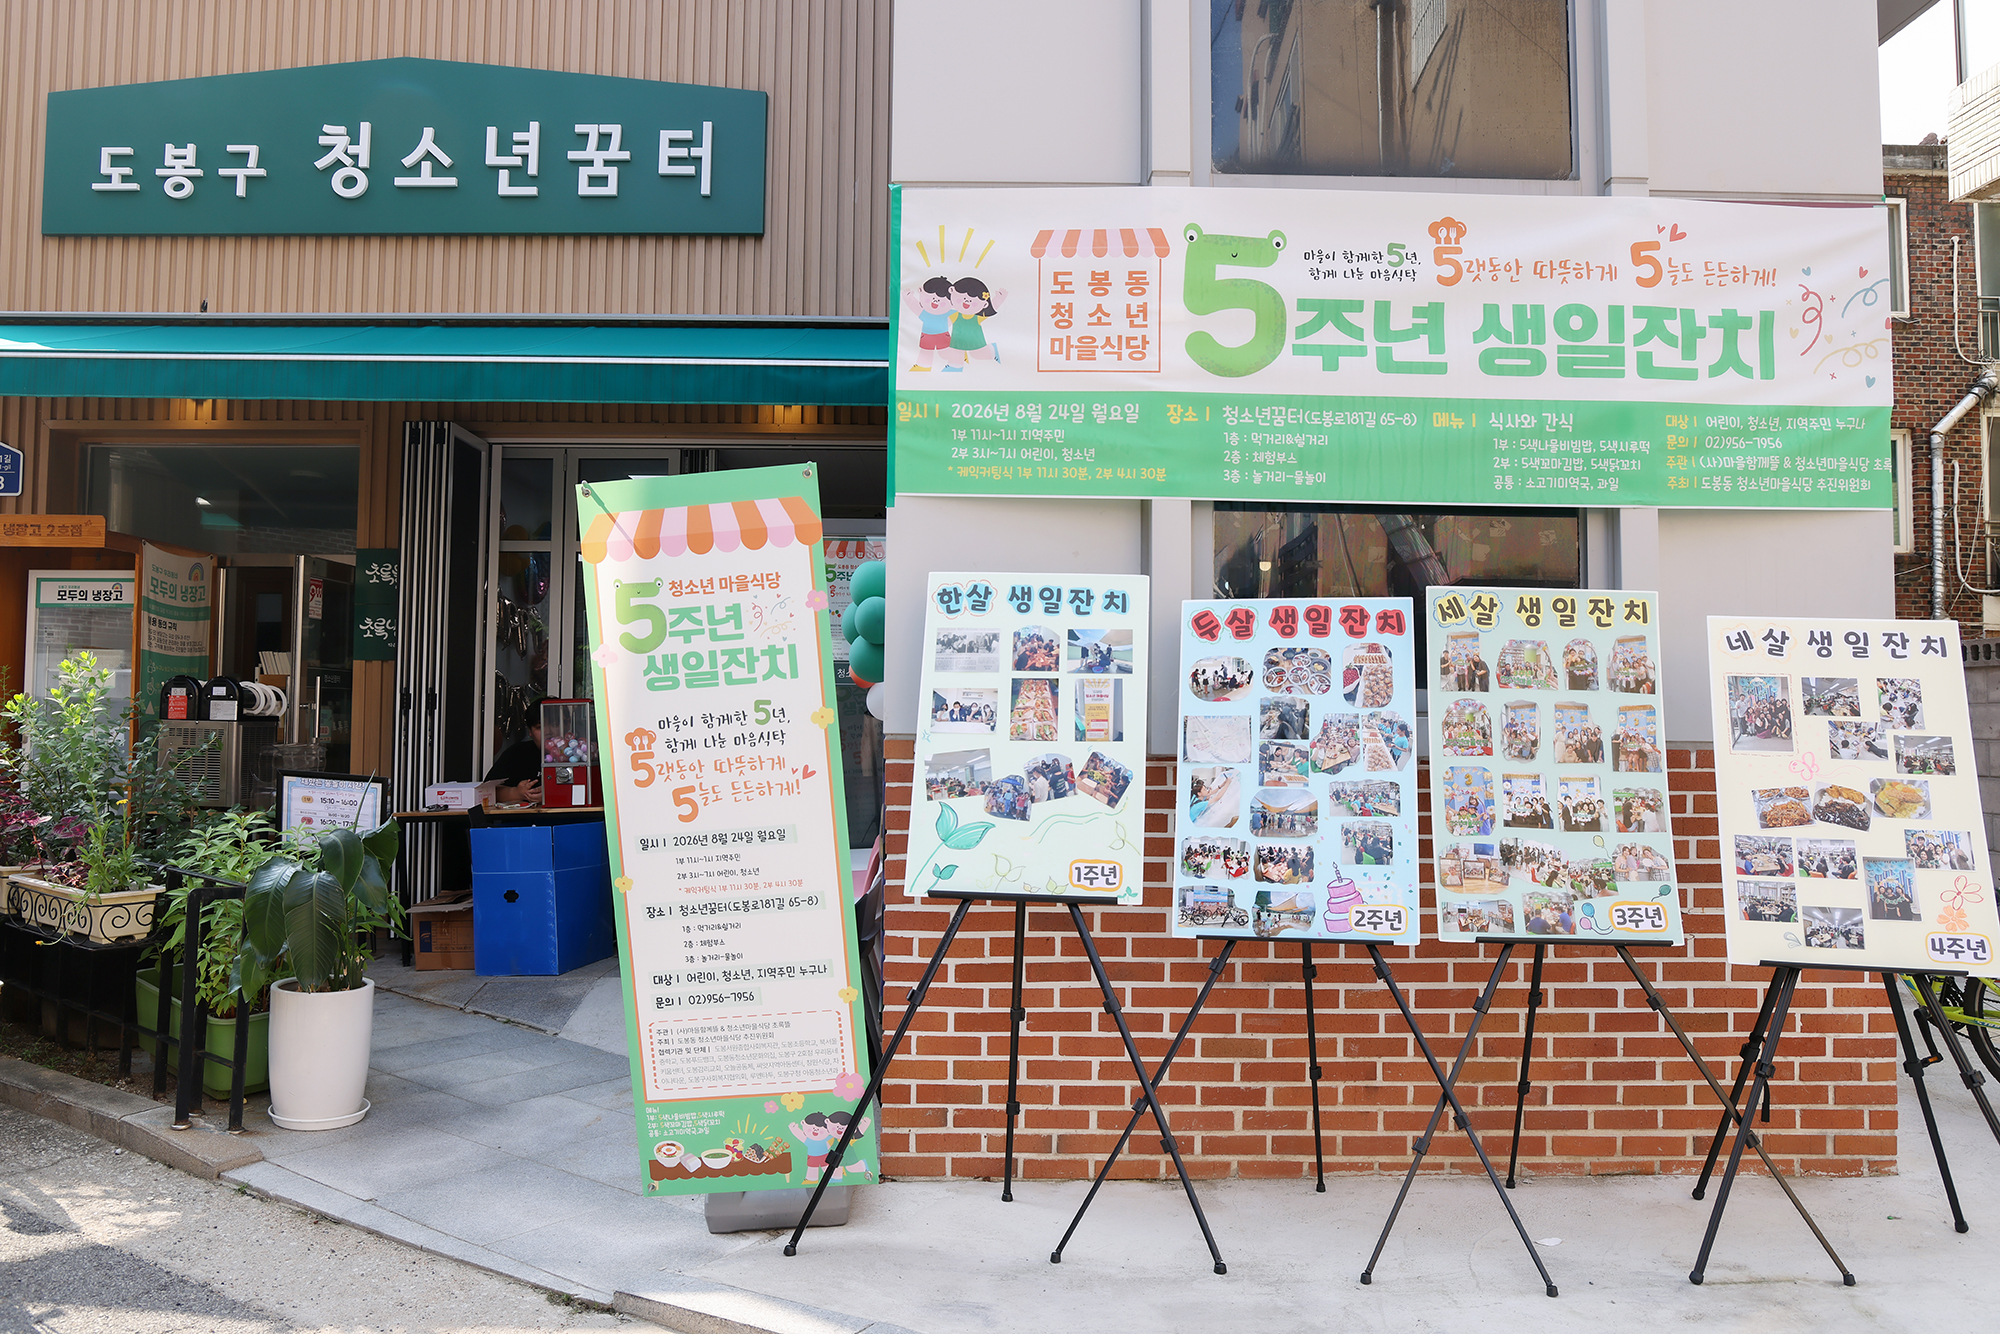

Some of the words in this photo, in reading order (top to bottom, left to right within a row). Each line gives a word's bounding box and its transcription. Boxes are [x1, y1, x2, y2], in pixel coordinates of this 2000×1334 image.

[91, 142, 268, 200] 도봉구
[313, 120, 716, 200] 청소년꿈터
[1304, 248, 1336, 264] 마을이
[1342, 250, 1384, 265] 함께한
[1387, 243, 1421, 268] 5년,
[1433, 246, 1523, 287] 5랫동안
[1533, 258, 1618, 285] 따뜻하게
[1630, 240, 1694, 288] 5늘도
[1703, 260, 1777, 287] 든든하게!
[1050, 270, 1150, 298] 도봉동
[1308, 267, 1337, 281] 함께
[1370, 268, 1417, 282] 마음식탁
[1183, 223, 1448, 379] 5주년
[1472, 303, 1776, 381] 생일잔치
[1050, 302, 1149, 330] 청소년
[1050, 334, 1150, 362] 마을식당
[897, 402, 928, 422] 일시
[951, 403, 1009, 422] 2026년
[1015, 403, 1042, 423] 8월
[1048, 404, 1085, 423] 24일
[1092, 404, 1140, 424] 월요일
[1167, 404, 1199, 424] 장소
[1222, 405, 1377, 428] 청소년꿈터(도봉로181길
[1380, 411, 1418, 427] 65-8)
[1432, 412, 1465, 429] 메뉴
[1489, 412, 1537, 431] 식사와
[1542, 412, 1574, 432] 간식
[1665, 414, 1689, 429] 대상
[1705, 415, 1743, 430] 어린이,
[1747, 416, 1782, 432] 청소년,
[1786, 417, 1832, 432] 지역주민
[1835, 417, 1866, 431] 누구나
[952, 429, 967, 442] 1부
[970, 429, 1017, 442] 11시~1시
[1021, 429, 1065, 443] 지역주민
[1223, 432, 1240, 446] 1층
[1251, 432, 1328, 447] 먹거리&쉴거리
[1493, 438, 1509, 451] 1부
[1519, 438, 1596, 454] 5색나물비빔밥,
[1600, 440, 1650, 455] 5색시루떡
[1666, 435, 1689, 450] 문의
[1705, 436, 1783, 449] 02)956-7956
[952, 447, 969, 459] 2부
[972, 447, 1017, 460] 3시~7시
[1020, 447, 1058, 461] 어린이,
[1062, 448, 1095, 462] 청소년
[1223, 450, 1242, 465] 2층
[1252, 451, 1298, 466] 체험부스
[1493, 457, 1511, 469] 2부
[1521, 457, 1587, 472] 5색꼬마김밥,
[1591, 458, 1641, 473] 5색닭꼬치
[1666, 455, 1688, 470] 주관
[1699, 455, 1780, 471] (사)마을함께뜰
[1783, 456, 1792, 469] &
[1795, 457, 1870, 473] 청소년마을식당
[957, 465, 1013, 480] 케익커팅식
[1017, 466, 1033, 479] 1부
[1037, 466, 1058, 479] 11시
[1062, 467, 1092, 480] 30분,
[1096, 467, 1114, 480] 2부
[1117, 467, 1136, 480] 4시
[1140, 468, 1167, 482] 30분
[1223, 469, 1241, 484] 3층
[1252, 470, 1326, 486] 놀거리-물놀이
[1493, 475, 1515, 490] 공통
[1525, 476, 1593, 491] 소고기미역국,
[1597, 477, 1619, 492] 과일
[1667, 477, 1689, 490] 주최
[1701, 476, 1733, 491] 도봉동
[1737, 476, 1813, 493] 청소년마을식당
[1817, 478, 1871, 493] 추진위원회
[3, 524, 41, 537] 냉장고
[47, 524, 82, 537] 2호점
[150, 576, 178, 601] 모두의
[180, 585, 206, 603] 냉장고
[668, 577, 715, 597] 청소년
[719, 571, 781, 592] 마을식당
[57, 590, 88, 601] 모두의
[92, 589, 123, 602] 냉장고
[937, 584, 993, 615] 한살
[1008, 585, 1127, 615] 생일잔치
[614, 577, 745, 654] 5주년
[1438, 595, 1498, 626] 세살
[1516, 596, 1648, 628] 생일잔치
[1192, 607, 1255, 639] 두살
[1271, 606, 1404, 638] 생일잔치
[1726, 628, 1790, 657] 네살
[1807, 630, 1948, 659] 생일잔치
[643, 643, 799, 692] 생일잔치
[658, 715, 694, 732] 마을이
[701, 710, 748, 729] 함께한
[754, 699, 791, 726] 5년,
[665, 738, 697, 754] 함께
[734, 729, 786, 747] 마음식탁
[630, 751, 705, 788] 5랫동안
[714, 754, 786, 776] 따뜻하게
[320, 797, 335, 805] 15:10
[672, 782, 723, 823] 5늘도
[731, 779, 801, 803] 든든하게!
[639, 838, 659, 851] 일시
[673, 834, 708, 847] 2026년
[711, 832, 728, 845] 8월
[730, 831, 753, 844] 24일
[757, 828, 786, 841] 월요일
[675, 857, 685, 865] 1부
[715, 853, 741, 863] 지역주민
[677, 872, 687, 880] 2부
[716, 869, 738, 878] 어린이,
[740, 867, 760, 876] 청소년
[1074, 865, 1118, 886] 1주년
[719, 884, 728, 892] 1부
[729, 883, 742, 891] 11시
[763, 881, 773, 889] 2부
[788, 879, 803, 887] 30분
[646, 906, 665, 919] 장소
[679, 897, 785, 917] 청소년꿈터(도봉로181길
[788, 894, 819, 908] 65-8)
[1354, 909, 1402, 931] 2주년
[1614, 907, 1662, 928] 3주년
[682, 925, 691, 934] 1층
[683, 940, 694, 949] 2층
[700, 938, 725, 947] 체험부스
[1931, 937, 1987, 962] 4주년
[685, 955, 695, 964] 3층
[653, 974, 673, 986] 대상
[686, 971, 719, 984] 어린이,
[722, 968, 754, 982] 청소년,
[757, 965, 796, 979] 지역주민
[799, 963, 828, 976] 누구나
[655, 997, 674, 1009] 문의
[688, 991, 755, 1006] 02)956-7956
